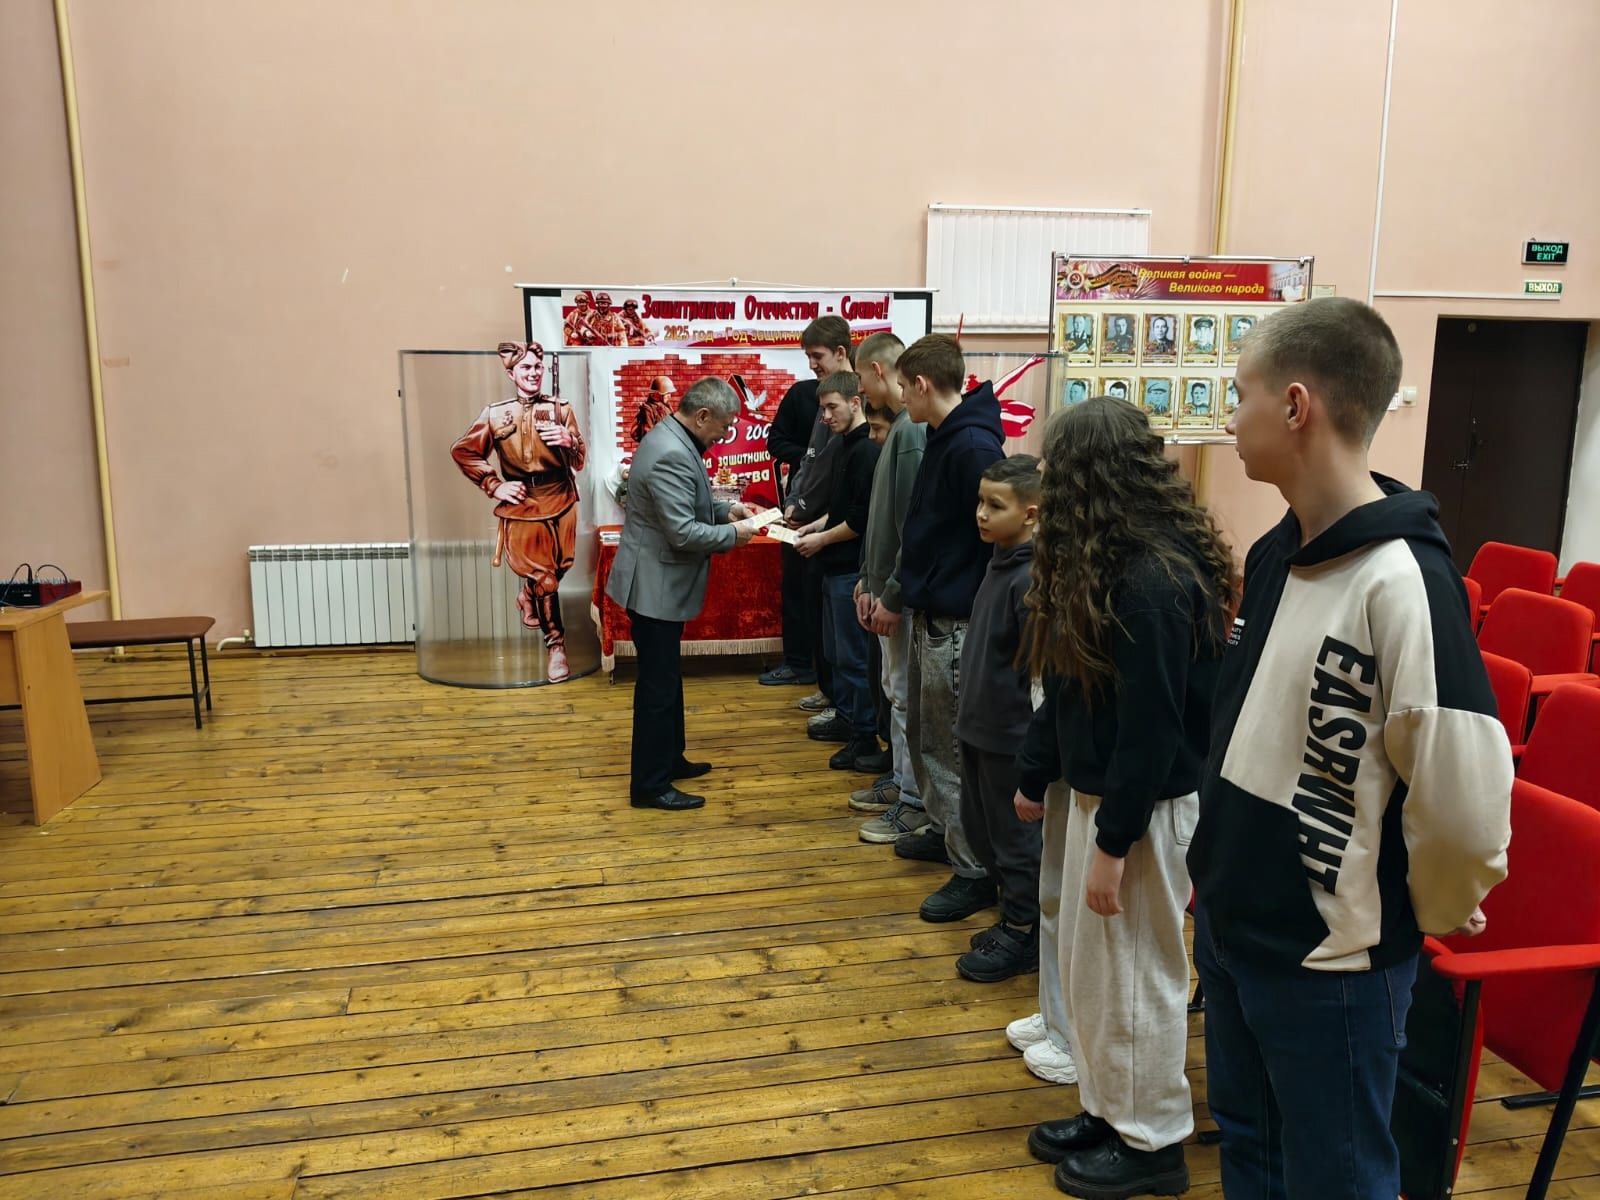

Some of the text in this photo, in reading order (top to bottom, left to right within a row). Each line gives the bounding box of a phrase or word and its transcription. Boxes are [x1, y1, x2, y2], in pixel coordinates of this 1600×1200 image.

[1531, 244, 1563, 254] ВЫХОД
[1536, 252, 1556, 260] EXIT
[1138, 268, 1185, 279] Великая
[1188, 269, 1221, 280] война
[1169, 282, 1264, 295] Великого народа
[1528, 283, 1559, 292] ВЫХОД
[744, 294, 819, 320] Отечества
[664, 325, 689, 341] 2025
[692, 330, 714, 343] год
[724, 327, 748, 343] Год
[751, 330, 803, 343] защитни
